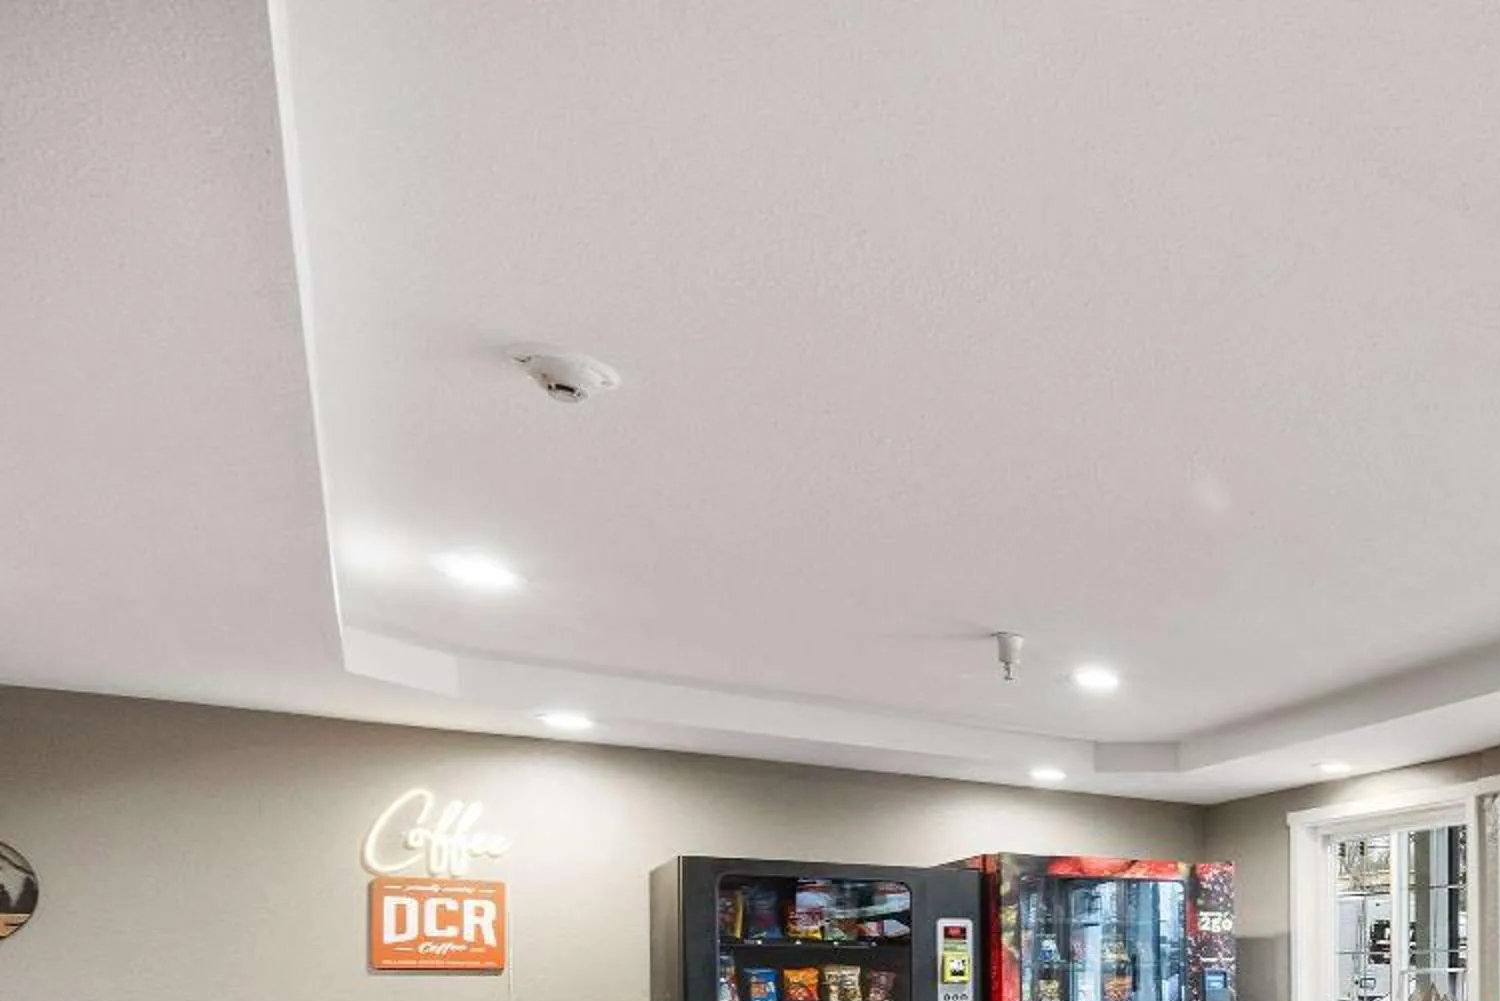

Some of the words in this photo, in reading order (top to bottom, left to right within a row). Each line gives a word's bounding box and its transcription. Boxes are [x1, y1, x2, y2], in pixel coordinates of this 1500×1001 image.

[364, 788, 510, 877] Coffee
[383, 895, 497, 947] DCR
[418, 941, 469, 958] Coffee
